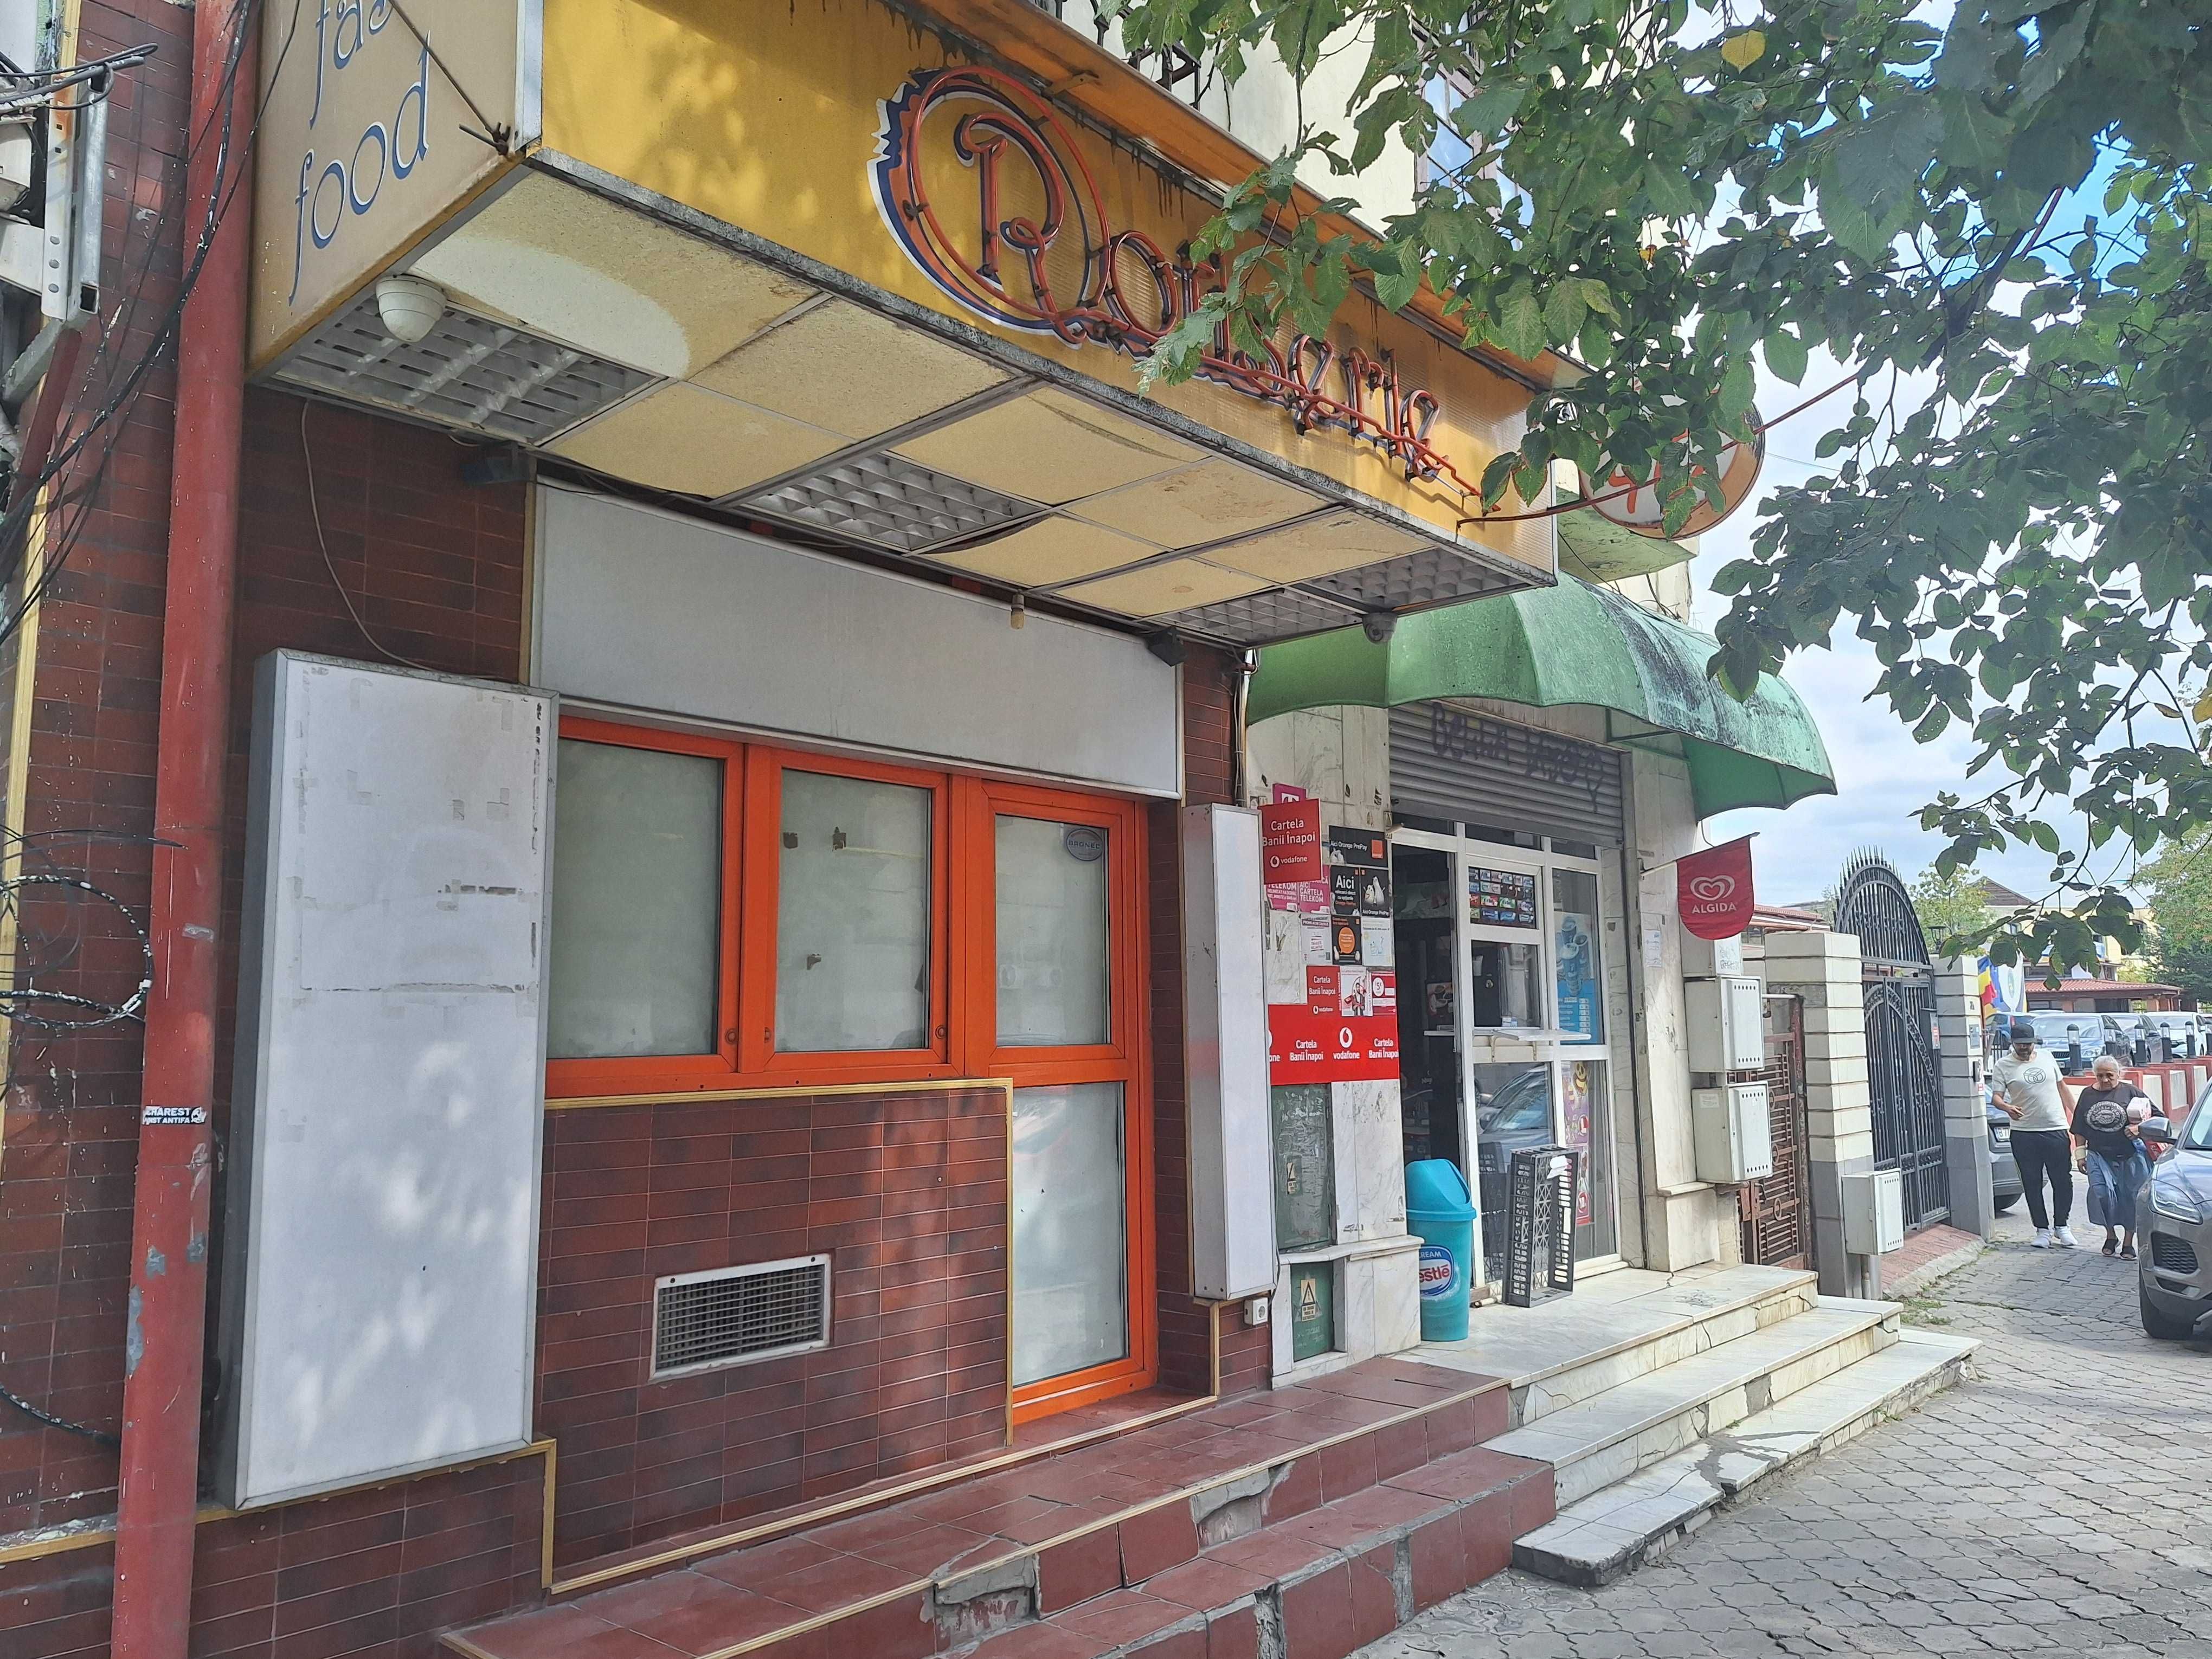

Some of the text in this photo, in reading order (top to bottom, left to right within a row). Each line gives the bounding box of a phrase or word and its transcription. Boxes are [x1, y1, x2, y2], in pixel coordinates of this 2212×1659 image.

[288, 30, 430, 306] food
[1271, 818, 1304, 831] Cartela
[1263, 831, 1315, 846] Banii Înapoi
[1281, 856, 1308, 864] vodafone
[1336, 874, 1354, 889] Aici
[1300, 895, 1323, 903] TELEKOM
[1692, 902, 1737, 914] ALGIDA
[1321, 986, 1336, 996] Înapoi
[1296, 1040, 1317, 1049] Cartela
[1374, 1038, 1393, 1047] Cartela
[1290, 1051, 1304, 1061] Banii
[1306, 1050, 1323, 1062] Înapoi
[1333, 1051, 1360, 1059] vodafone
[1368, 1047, 1399, 1059] Banii Înapoi
[1418, 1264, 1450, 1283] estlé
